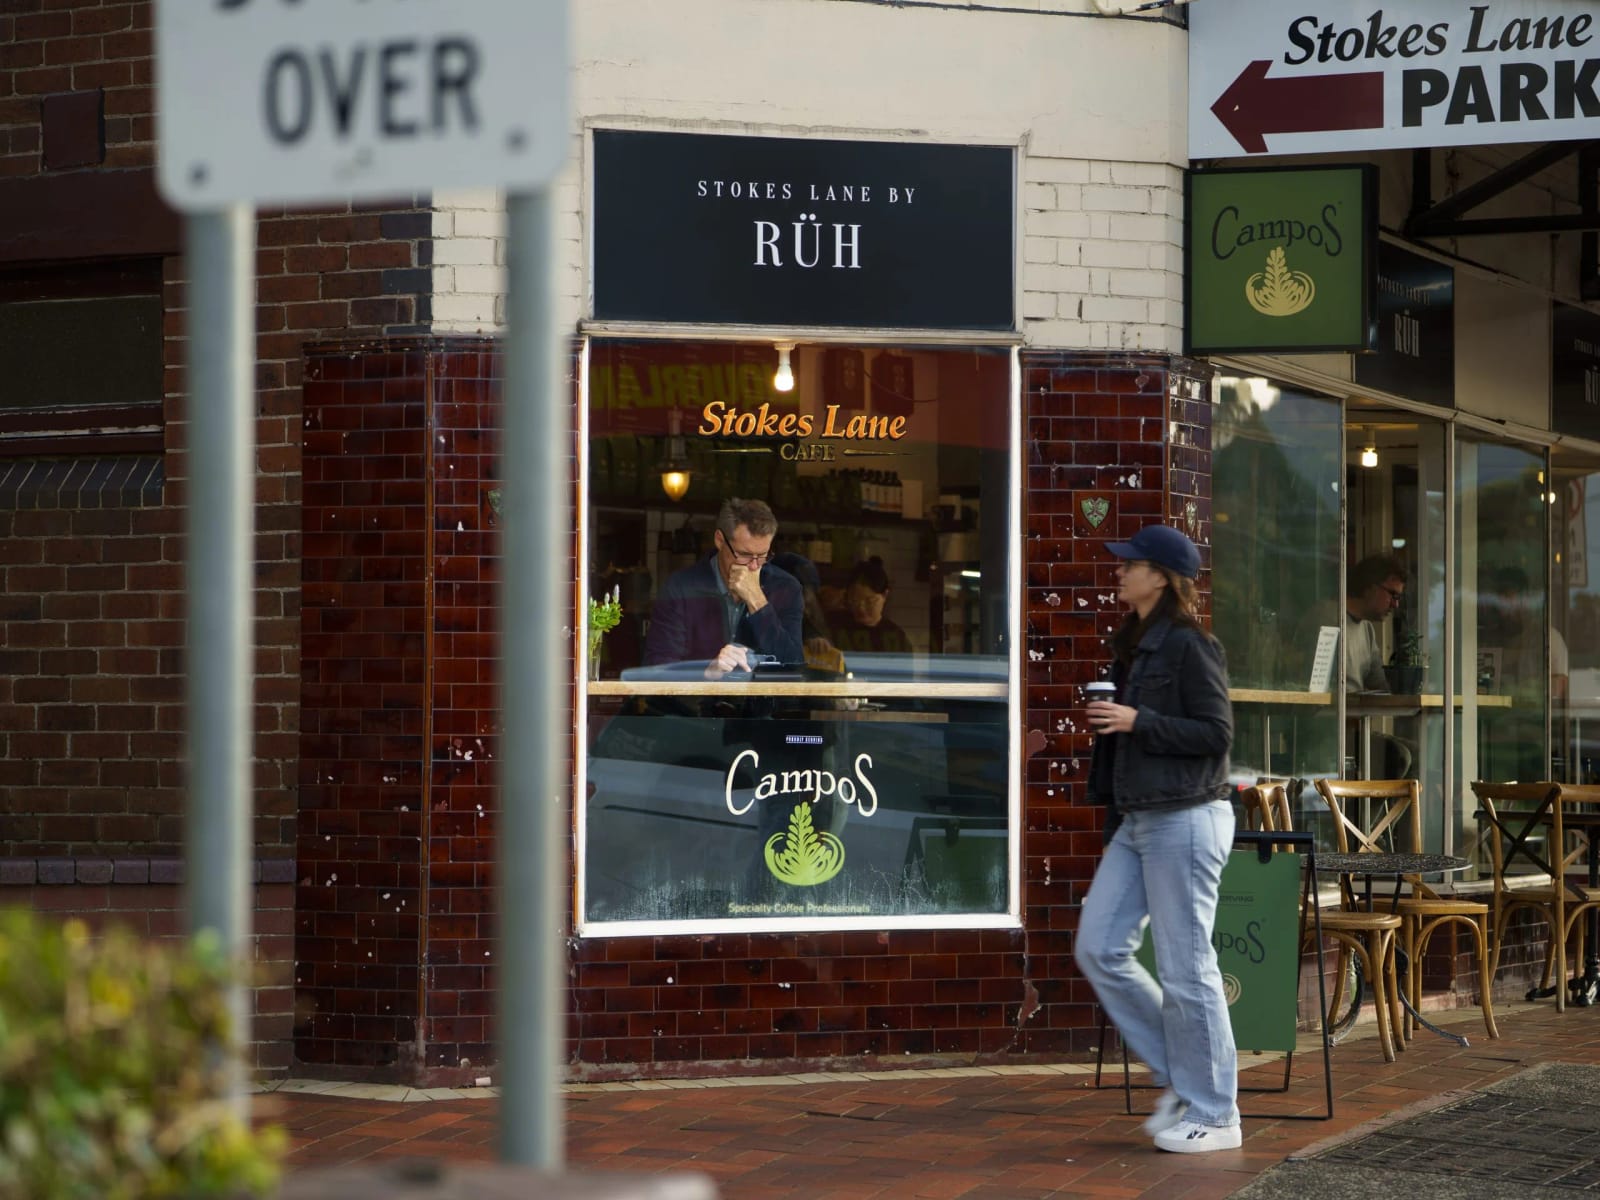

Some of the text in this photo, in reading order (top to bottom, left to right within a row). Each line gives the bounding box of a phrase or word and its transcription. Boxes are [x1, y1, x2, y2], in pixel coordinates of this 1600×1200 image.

[1284, 5, 1593, 65] Stokes Lane
[263, 34, 481, 146] OVER
[1402, 58, 1600, 127] PARK
[697, 180, 915, 204] STOKES LANE BY
[753, 213, 862, 269] RÜH
[699, 401, 907, 439] Stokes Lane
[780, 443, 836, 461] CAFE
[728, 901, 870, 914] Specialty Coffee Professionals
